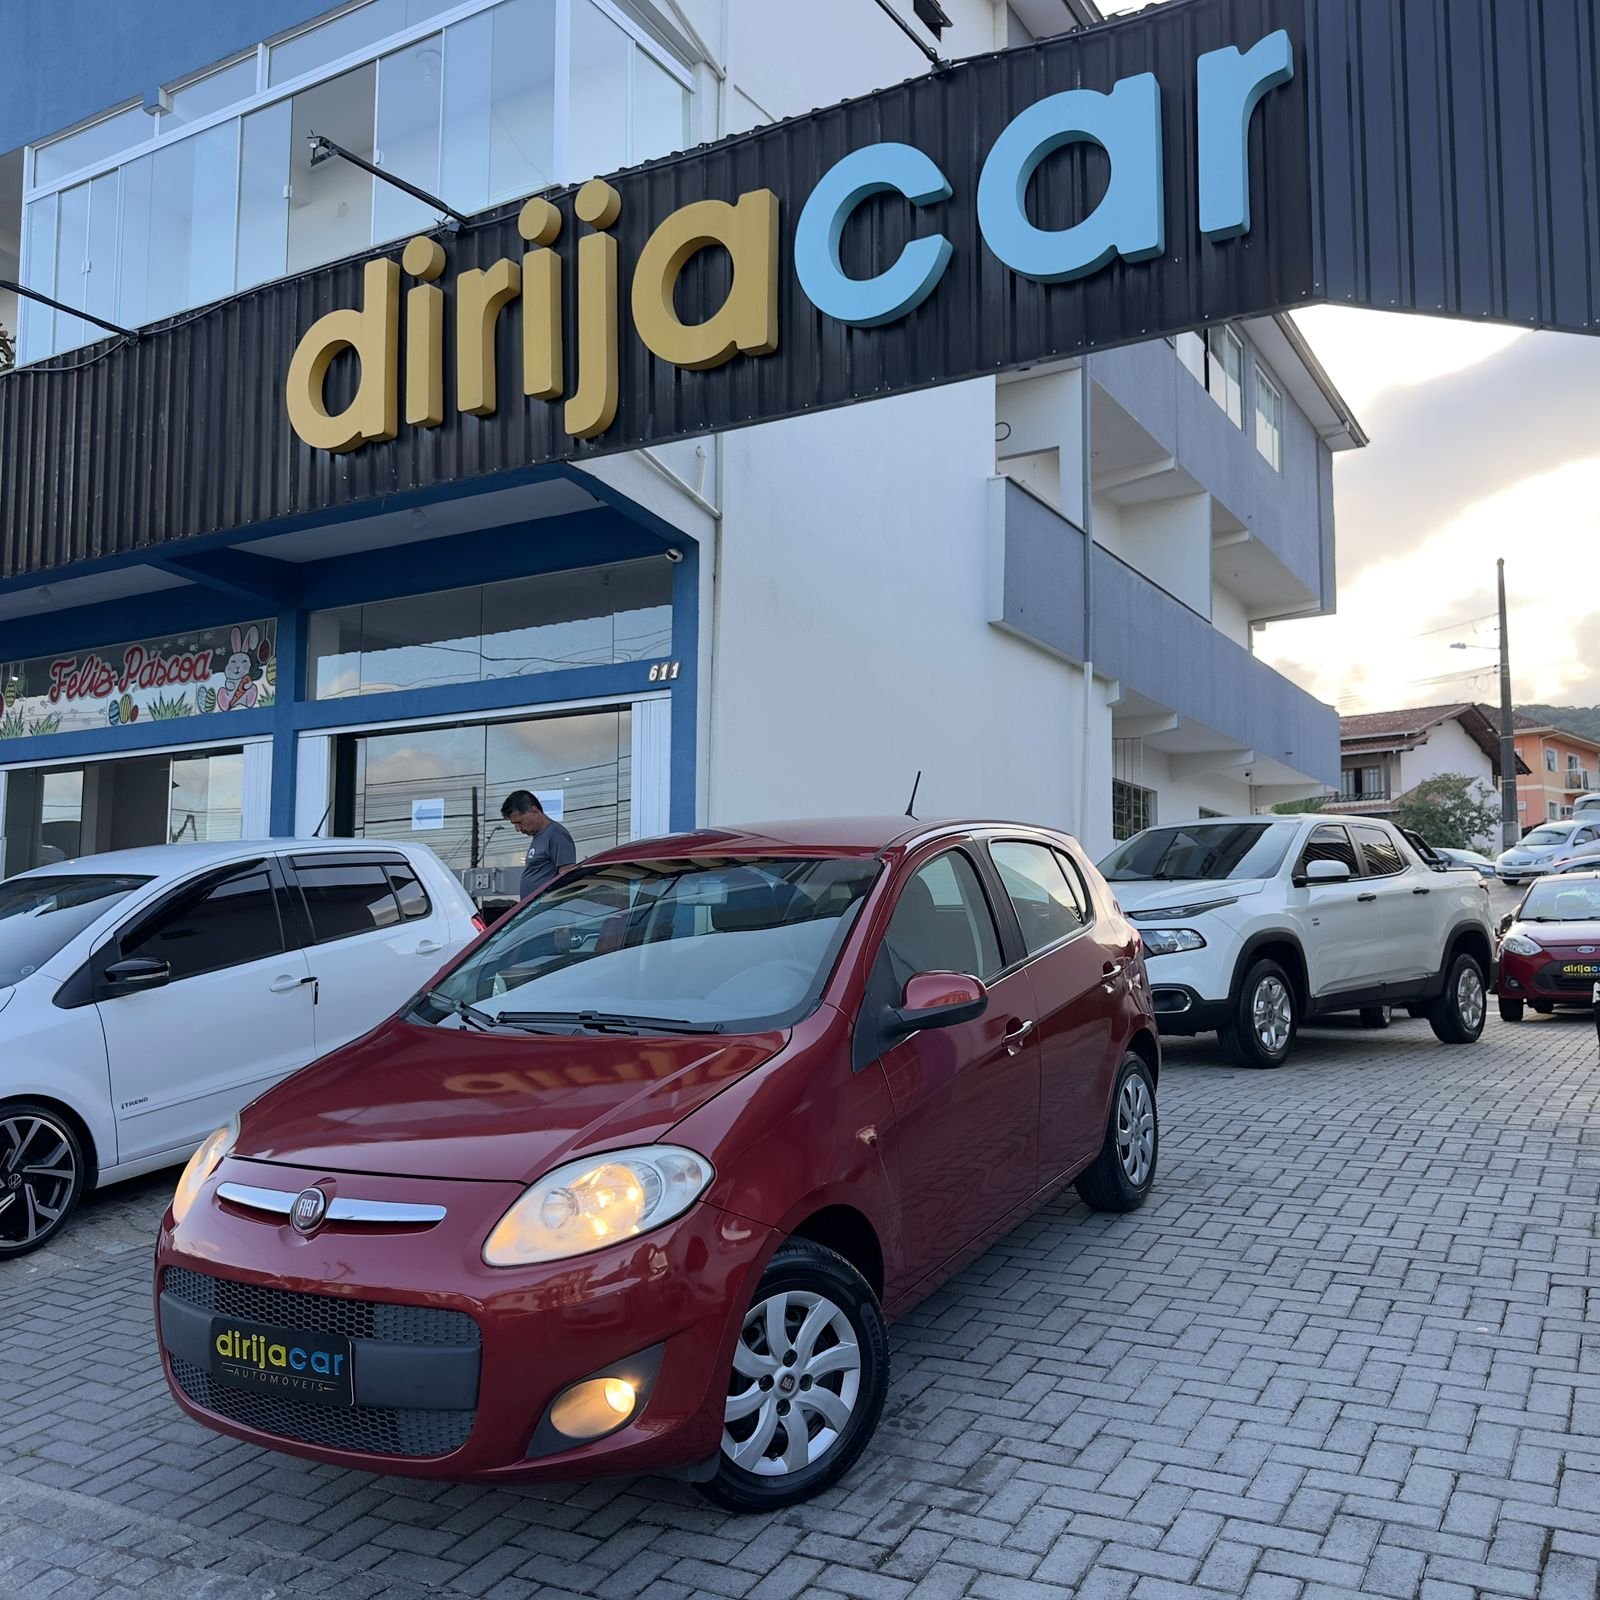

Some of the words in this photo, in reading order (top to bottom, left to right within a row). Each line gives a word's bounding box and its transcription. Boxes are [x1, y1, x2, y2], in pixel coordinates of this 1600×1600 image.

[286, 29, 1294, 454] dirijacar
[50, 653, 117, 703] Feliz
[118, 645, 212, 693] Páscoa
[648, 662, 679, 681] 611
[1563, 964, 1600, 973] dirijac
[297, 1198, 318, 1217] FIAT
[215, 1330, 344, 1376] dirijacar
[233, 1368, 324, 1392] AUTOMÓVEIS
